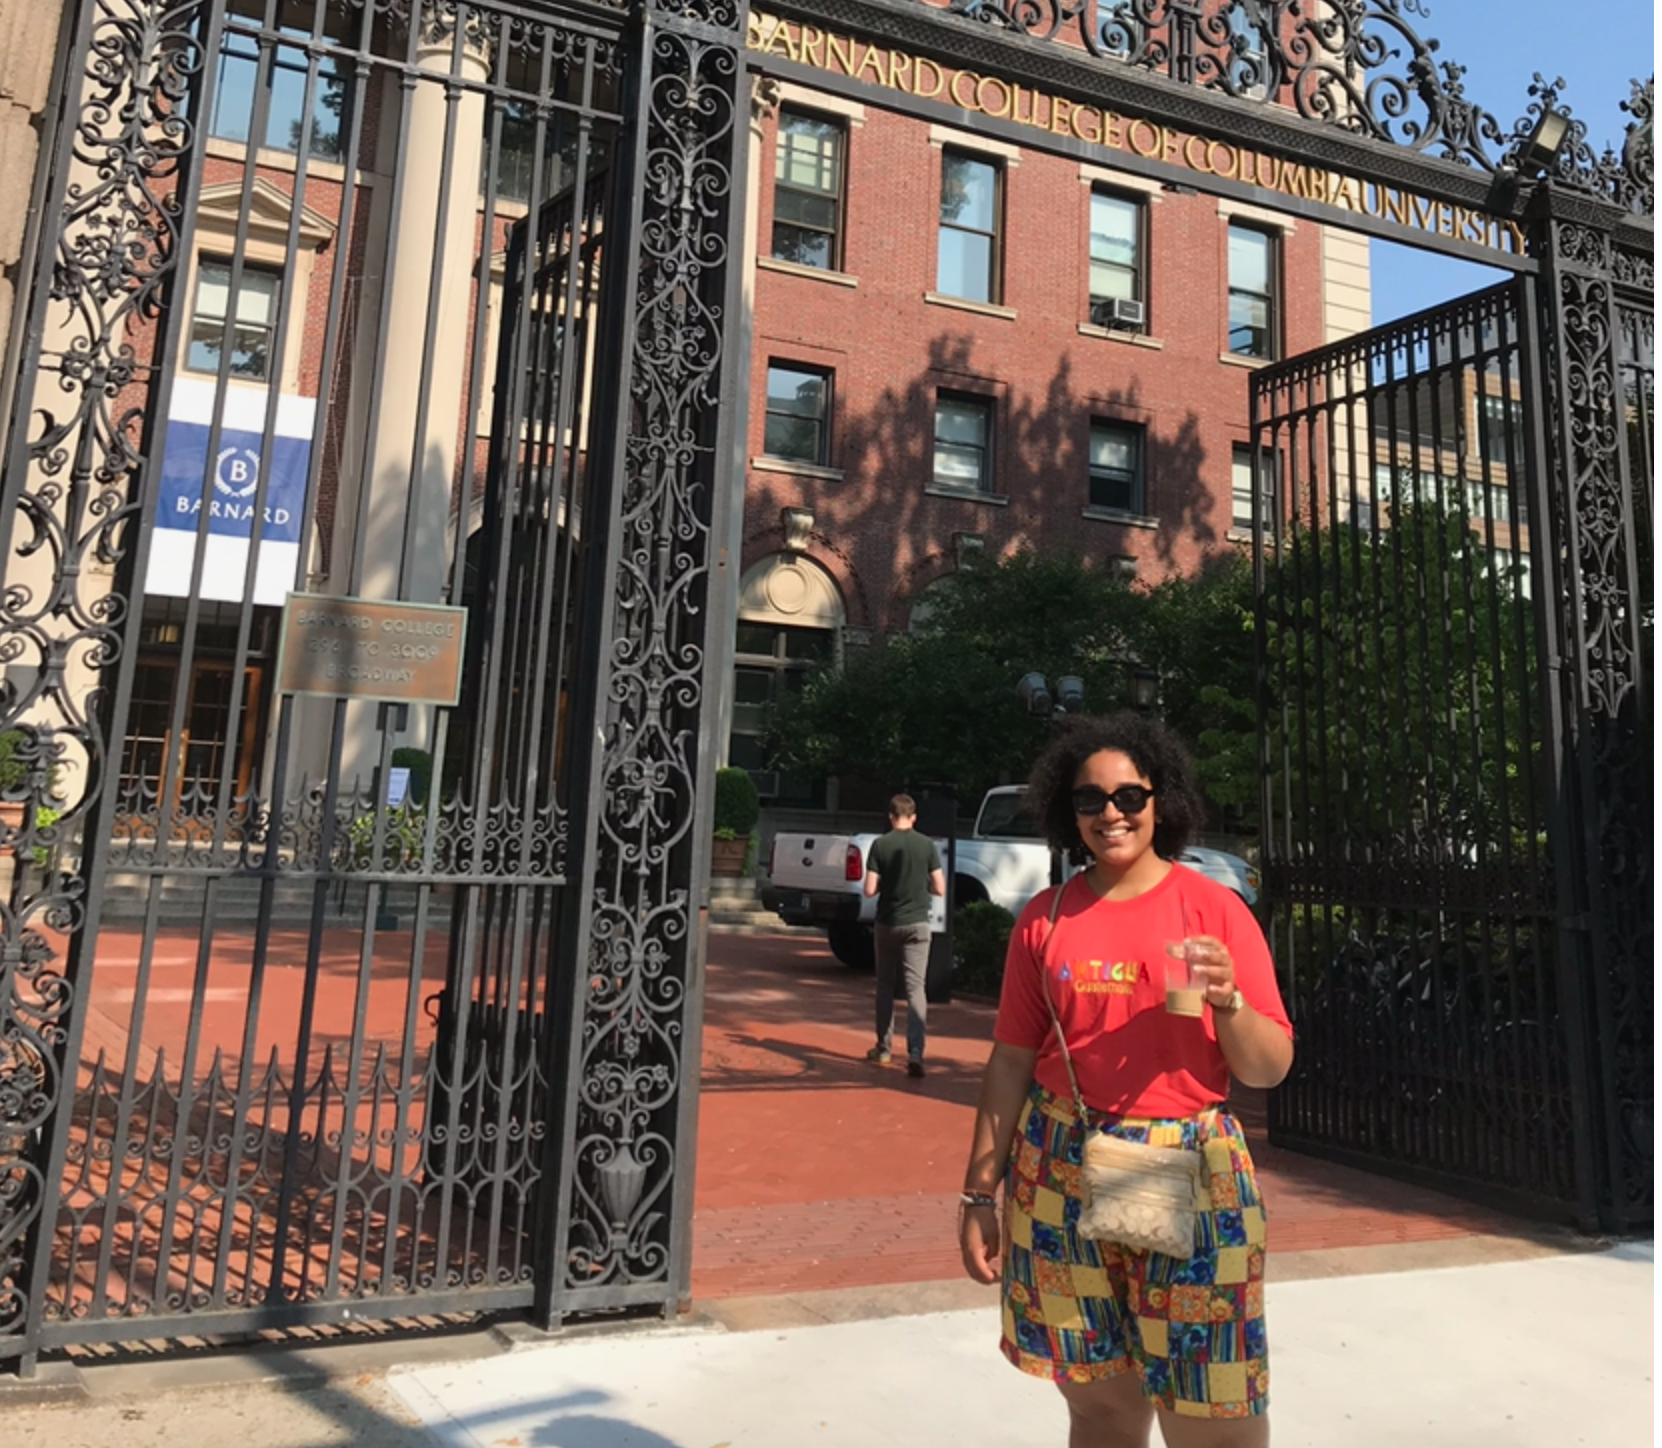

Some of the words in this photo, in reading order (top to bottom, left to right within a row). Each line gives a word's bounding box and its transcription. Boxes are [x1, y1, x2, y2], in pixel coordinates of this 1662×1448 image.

[746, 11, 945, 98] BARNARD
[950, 69, 1122, 149] COLLEGE
[1128, 118, 1177, 160] OF
[1183, 136, 1357, 206] COLUMBIA
[1358, 182, 1528, 257] UNIVERSITY
[229, 459, 248, 483] B
[176, 496, 290, 525] BARNARD
[298, 610, 372, 630] BARNARD
[381, 618, 455, 639] COLLEGE
[357, 640, 381, 656] TO
[326, 663, 417, 682] BROADWAY
[1058, 960, 1150, 983] ANTIGUA
